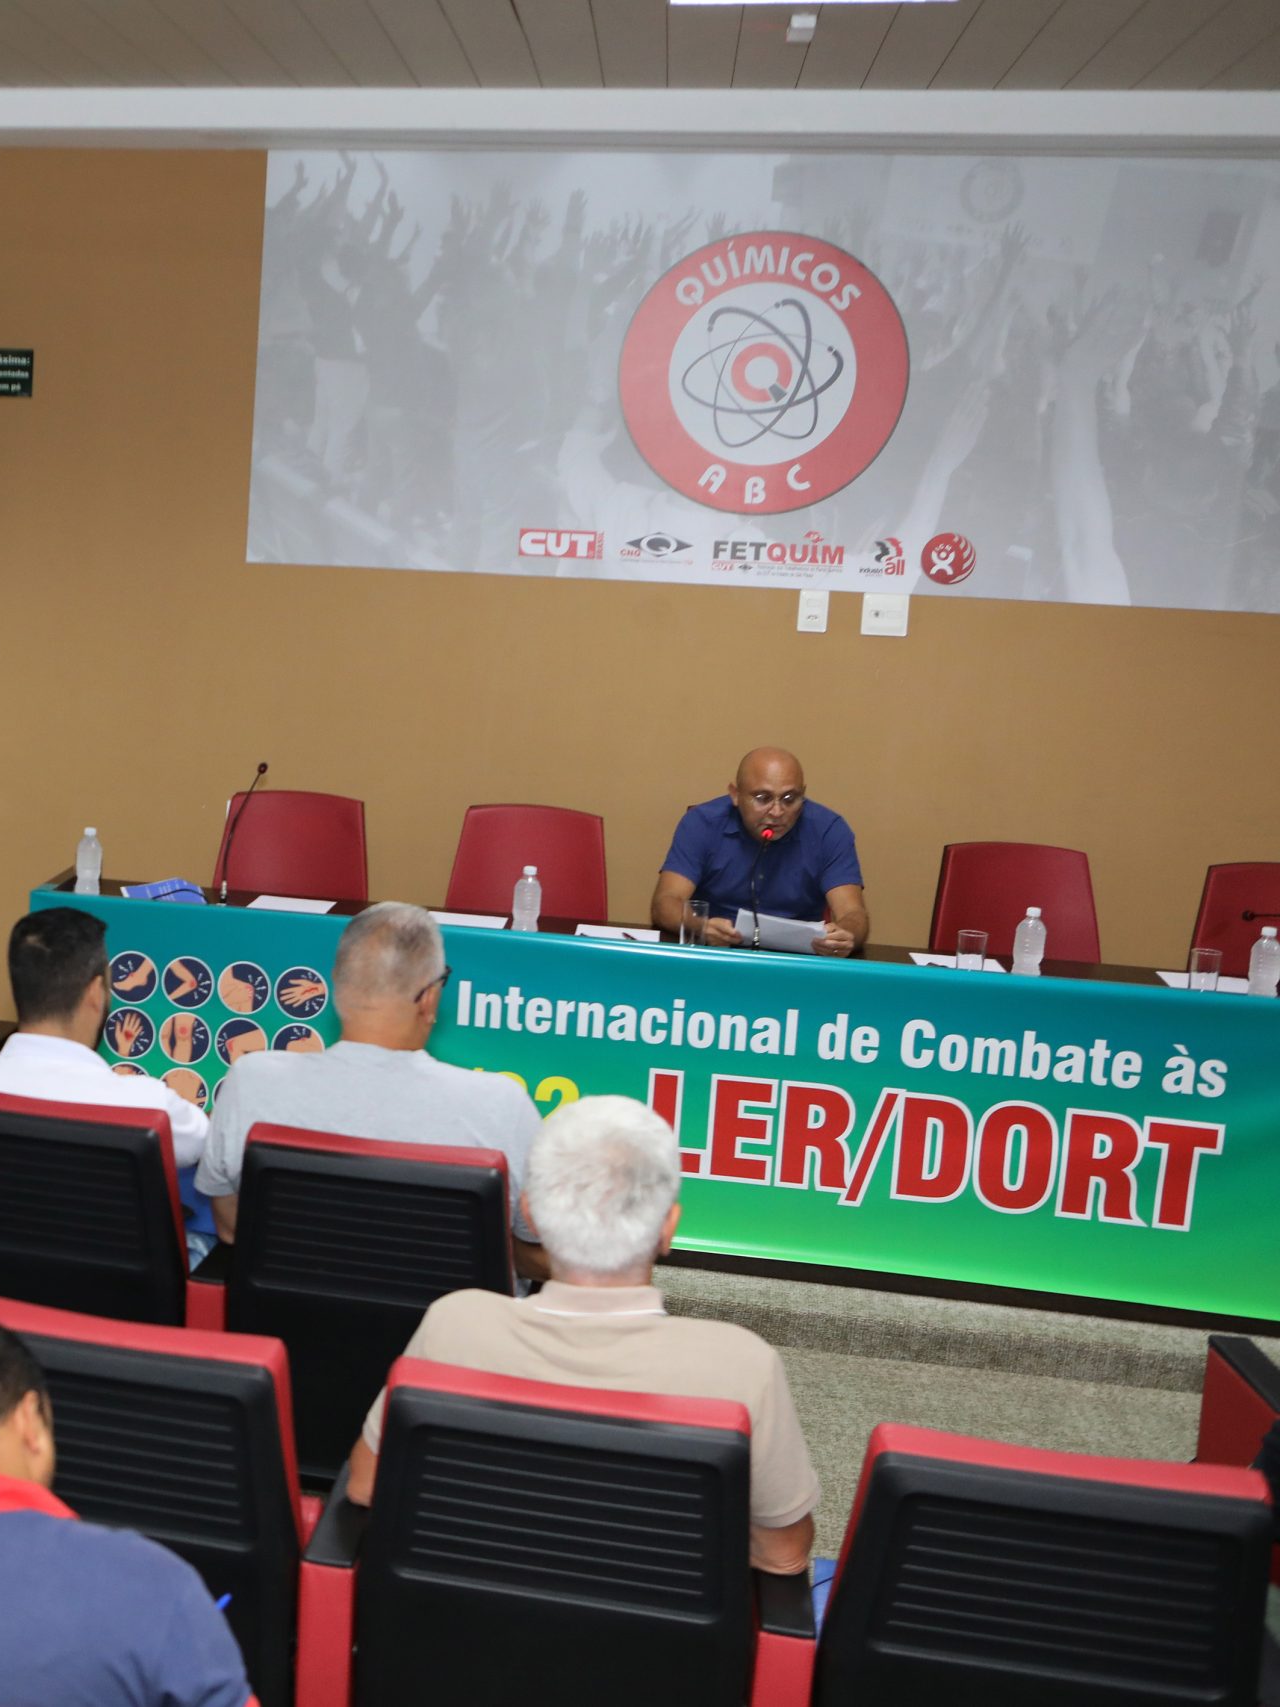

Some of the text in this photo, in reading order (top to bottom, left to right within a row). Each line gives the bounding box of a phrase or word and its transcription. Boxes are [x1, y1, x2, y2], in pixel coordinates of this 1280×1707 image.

[675, 240, 861, 311] QUÍMICOS
[520, 531, 596, 557] CUT
[456, 980, 1229, 1098] Internacional de Combate às
[647, 1067, 1227, 1233] LER/DORT
